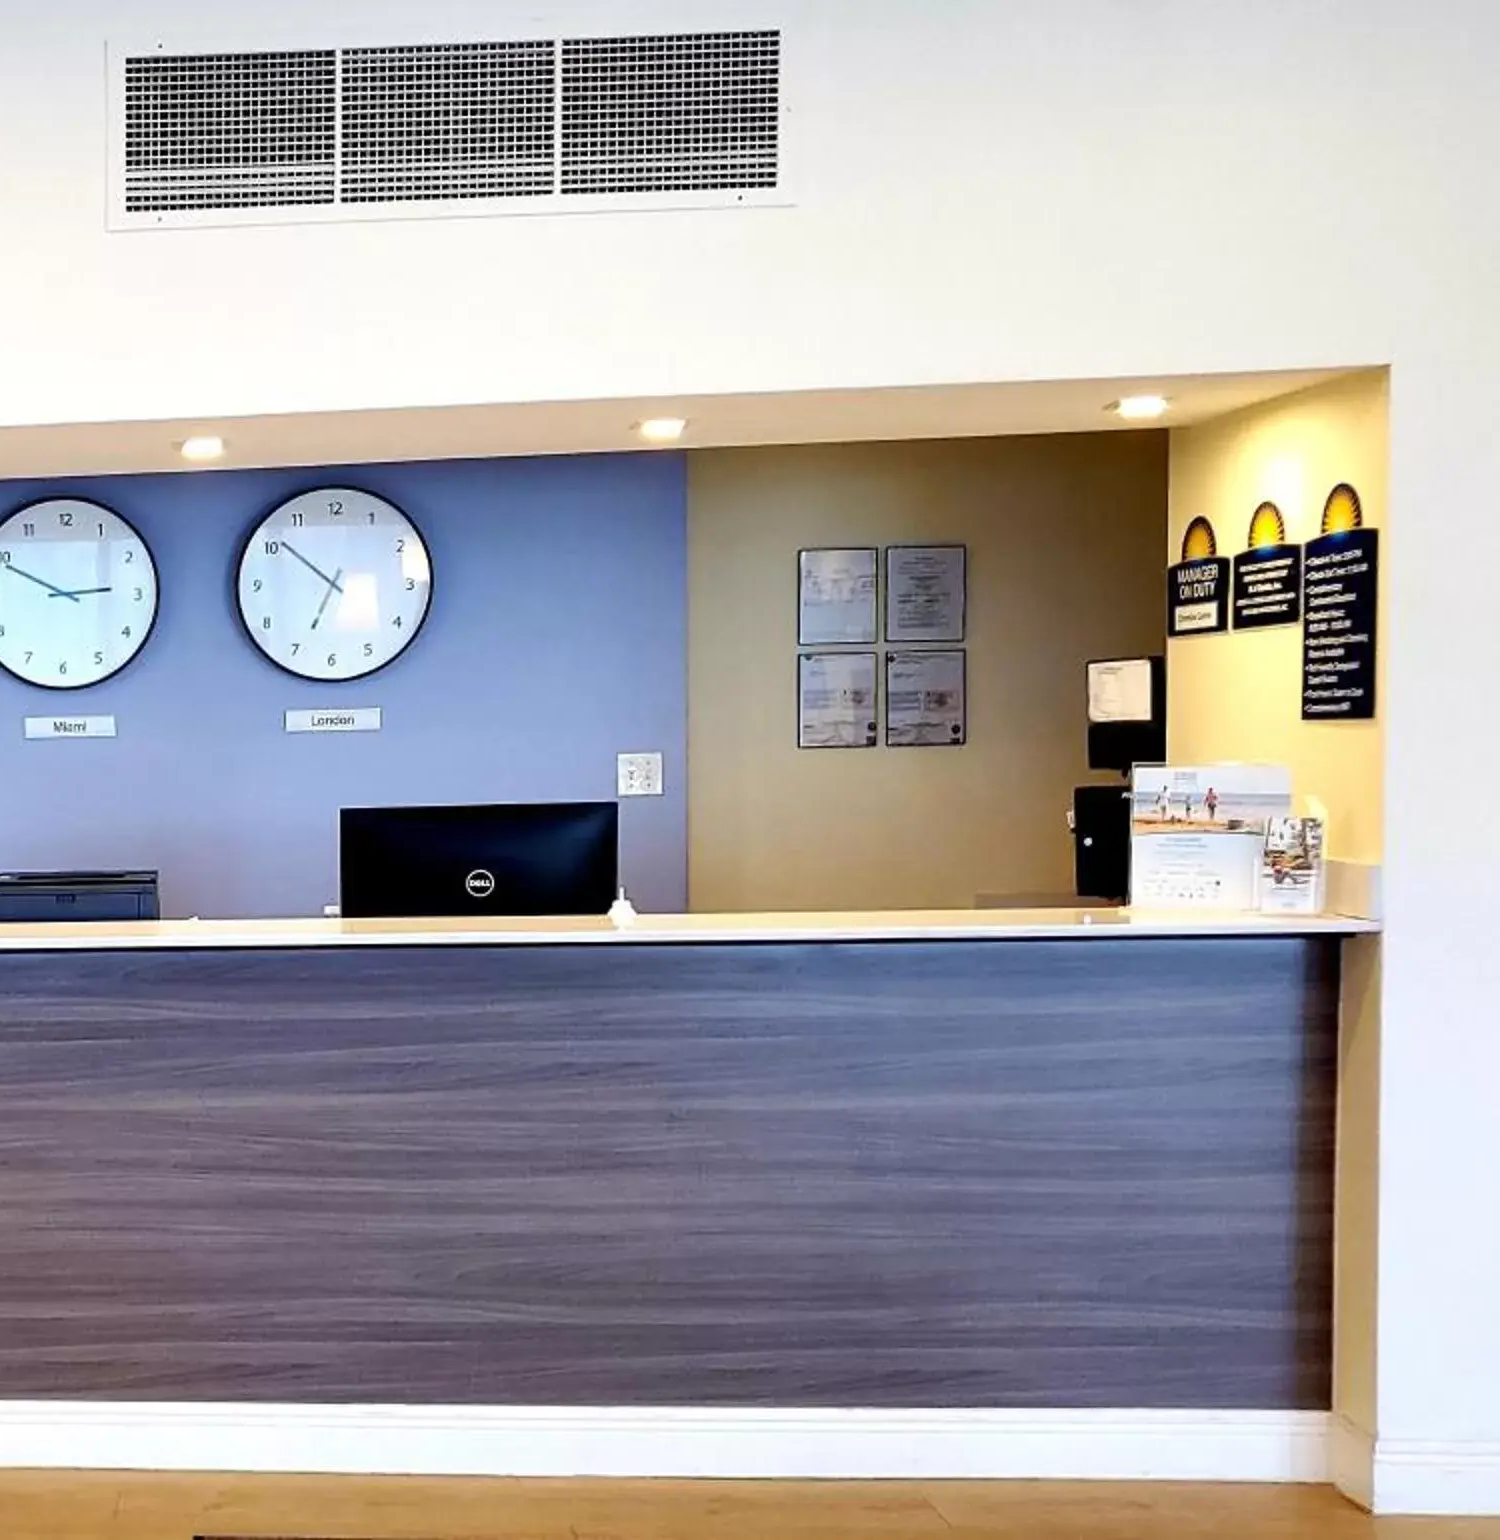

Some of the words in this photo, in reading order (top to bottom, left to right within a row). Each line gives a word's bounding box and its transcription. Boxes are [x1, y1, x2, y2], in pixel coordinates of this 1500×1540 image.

[328, 502, 343, 516] 12
[59, 513, 73, 526] 12
[291, 513, 303, 526] 11
[23, 524, 35, 536] 11
[265, 541, 279, 555] 10
[396, 539, 405, 552] 2
[125, 552, 133, 563] 2
[1177, 564, 1219, 584] MANAGER
[253, 579, 262, 592] 9
[406, 578, 415, 591] 3
[1179, 584, 1193, 600] ON
[1193, 580, 1217, 598] DUTY
[133, 588, 143, 601] 3
[263, 616, 271, 630] 8
[392, 615, 401, 629] 4
[121, 625, 131, 638] 4
[291, 643, 300, 656] 7
[364, 643, 373, 656] 5
[24, 652, 33, 664] 7
[94, 652, 103, 664] 5
[328, 653, 336, 667] 6
[59, 661, 67, 674] 6
[53, 720, 87, 734] Miami
[311, 715, 355, 727] London
